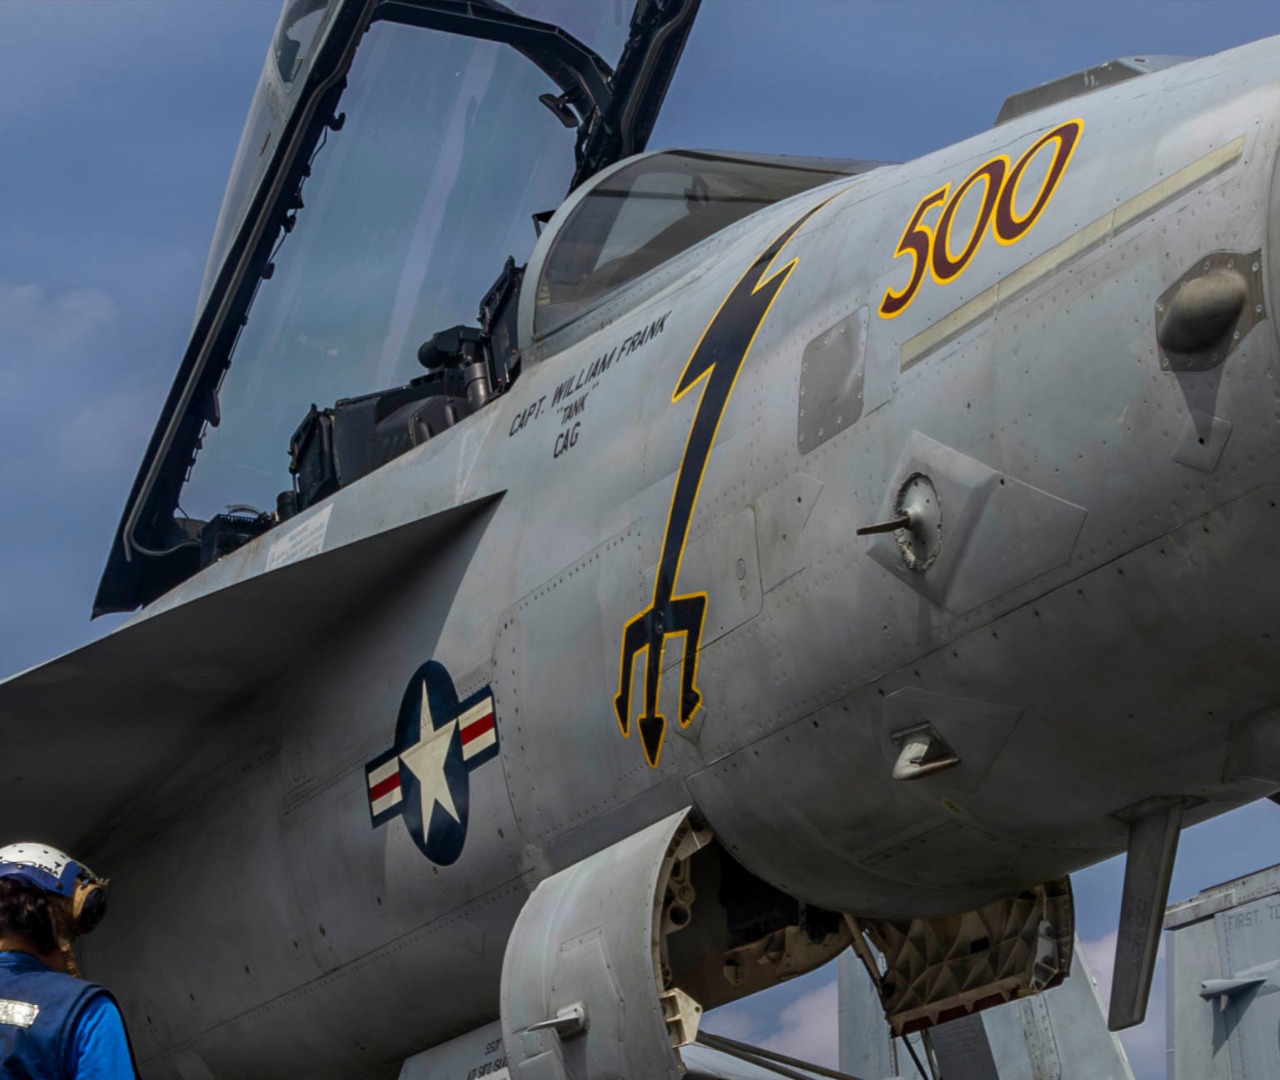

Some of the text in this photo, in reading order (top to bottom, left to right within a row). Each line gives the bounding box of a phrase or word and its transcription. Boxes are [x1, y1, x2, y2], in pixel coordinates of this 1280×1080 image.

[878, 118, 1084, 319] 500
[509, 310, 672, 437] CAPT. WILLIAM FRANK
[553, 421, 581, 459] CAG
[1228, 909, 1260, 930] FIRST
